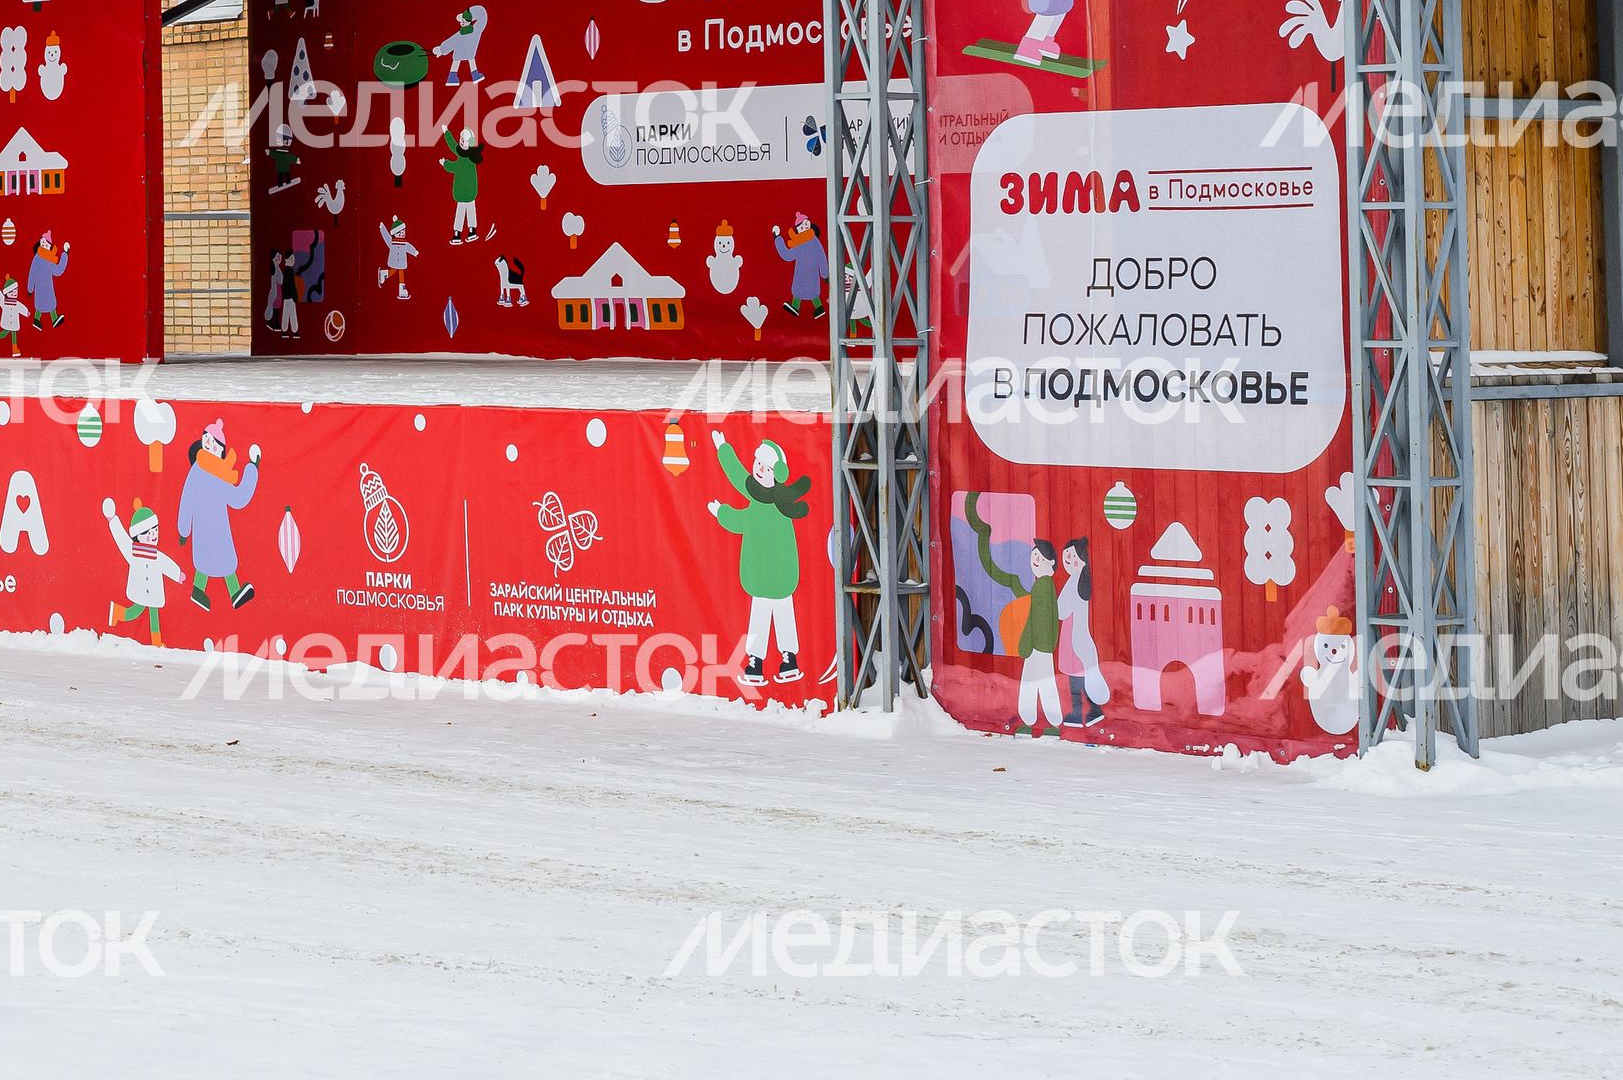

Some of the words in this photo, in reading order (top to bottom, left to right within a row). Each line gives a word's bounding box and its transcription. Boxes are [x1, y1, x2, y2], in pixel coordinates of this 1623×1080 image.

[678, 29, 691, 52] в
[636, 123, 692, 143] ПАРКИ
[636, 144, 771, 166] ПОДМОСКОВЬЯ
[1000, 170, 1141, 215] ЗИМА
[1149, 185, 1159, 198] в
[1169, 178, 1314, 201] Подмосковье
[1086, 256, 1217, 297] ДОБРО
[1023, 313, 1282, 347] ПОЖАЛОВАТЬ
[994, 367, 1013, 399] В
[1024, 367, 1309, 409] ПОДМОСКОВЬЕ
[366, 571, 412, 590] ПАРКИ
[489, 580, 563, 603] ЗАРАЙСКИЙ
[565, 587, 657, 608] ЦЕНТРАЛЬНЫЙ
[336, 588, 445, 612] ПОДМОСКОВЬЯ
[493, 601, 523, 618] ПАРК
[526, 604, 585, 623] КУЛЬТУРЫ
[588, 608, 598, 622] И
[602, 610, 655, 628] ОТДЫХА
